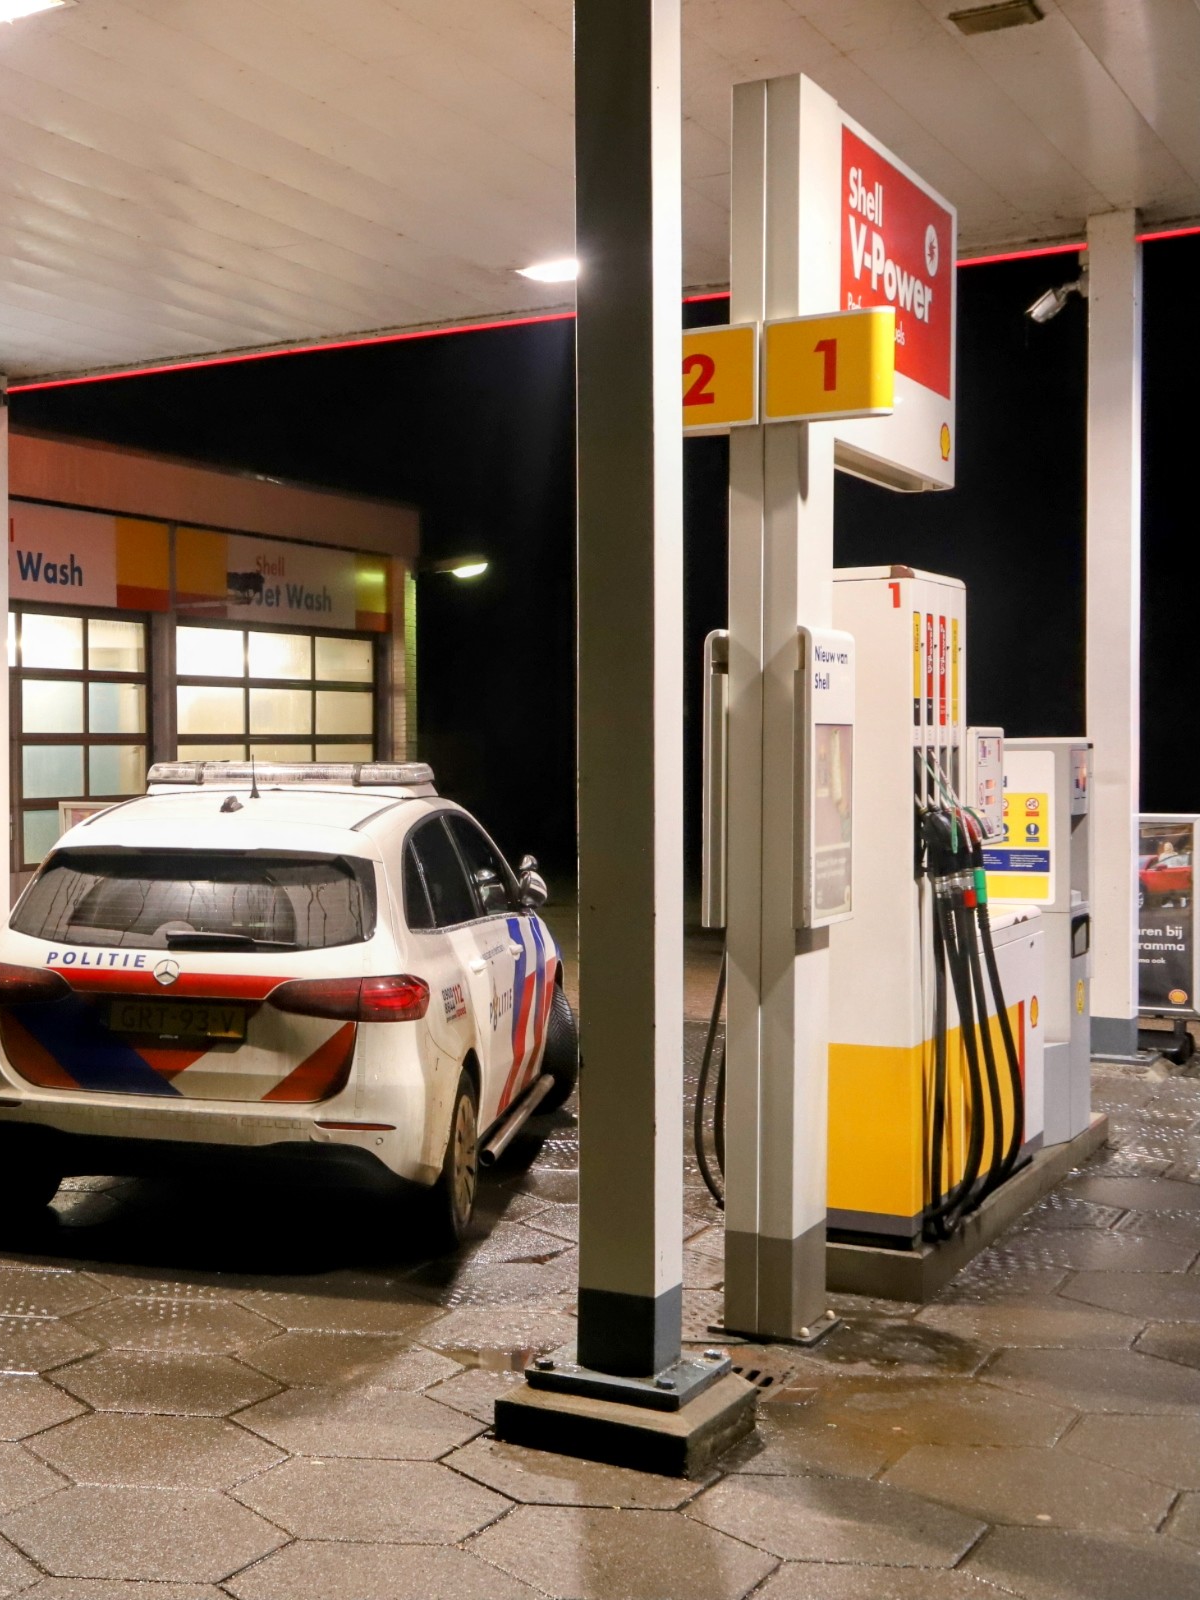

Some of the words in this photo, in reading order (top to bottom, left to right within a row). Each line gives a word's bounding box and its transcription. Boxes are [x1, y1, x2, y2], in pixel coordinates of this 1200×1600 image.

[849, 166, 883, 229] Shell
[849, 215, 932, 324] V-Power
[814, 338, 837, 391] 1
[682, 354, 715, 407] 2
[16, 549, 83, 587] Wash
[255, 554, 285, 577] Shell
[286, 583, 332, 613] Wash
[888, 582, 901, 608] 1
[814, 646, 835, 664] Nieuw
[836, 652, 848, 665] van
[814, 672, 830, 690] Shell
[1166, 925, 1183, 940] bij
[46, 951, 147, 968] POLITIE
[1137, 942, 1186, 951] ramma
